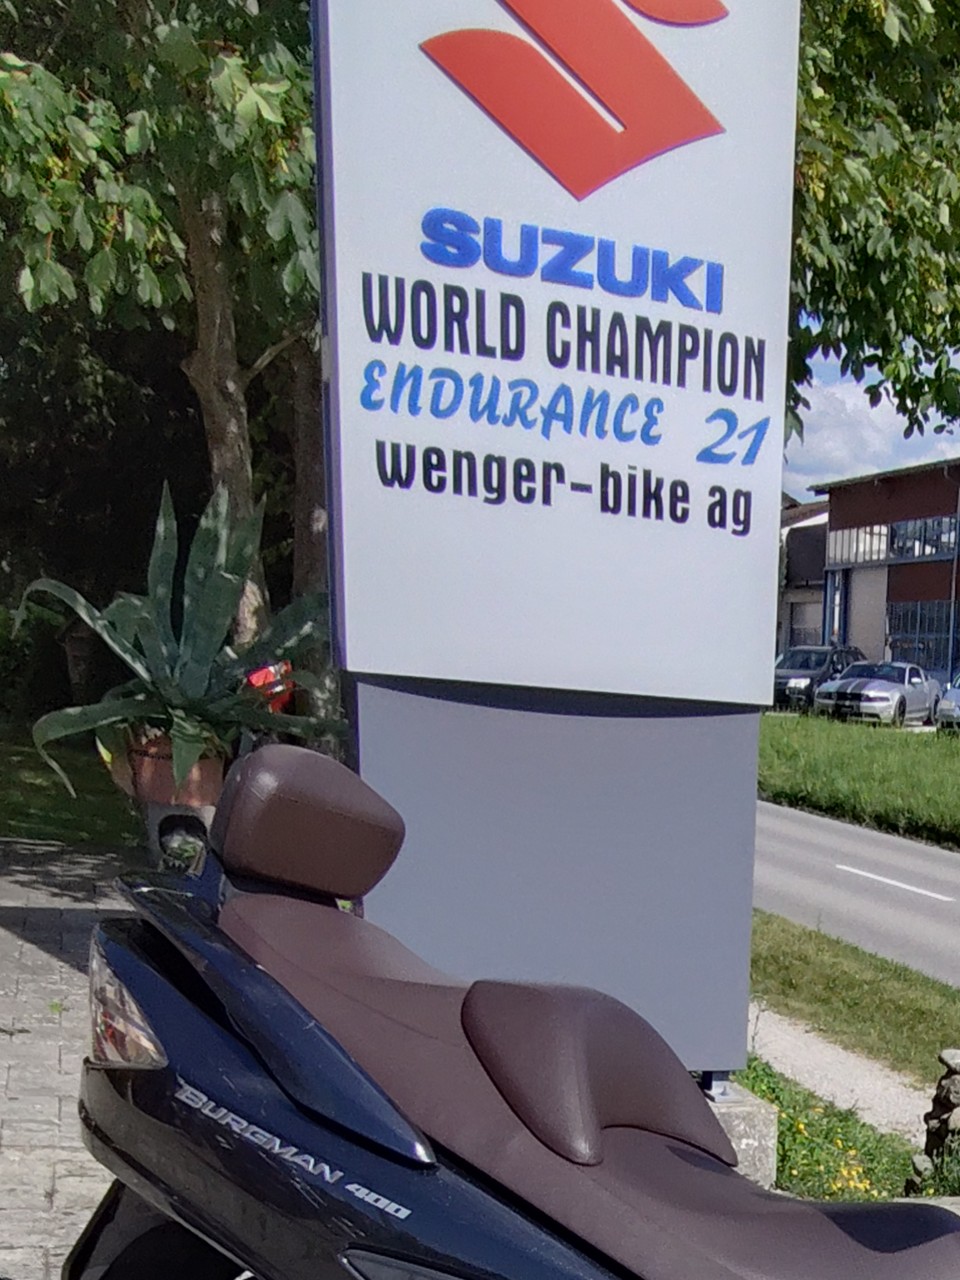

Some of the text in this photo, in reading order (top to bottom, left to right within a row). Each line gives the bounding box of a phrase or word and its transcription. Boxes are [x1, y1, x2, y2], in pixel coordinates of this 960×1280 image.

[420, 207, 724, 315] SUZUKI
[361, 272, 766, 402] WORLD CHAMPION
[359, 359, 771, 466] ENDURANCE 21
[375, 439, 752, 537] wenger-bike ag
[174, 1083, 412, 1220] BURGMAN 400
